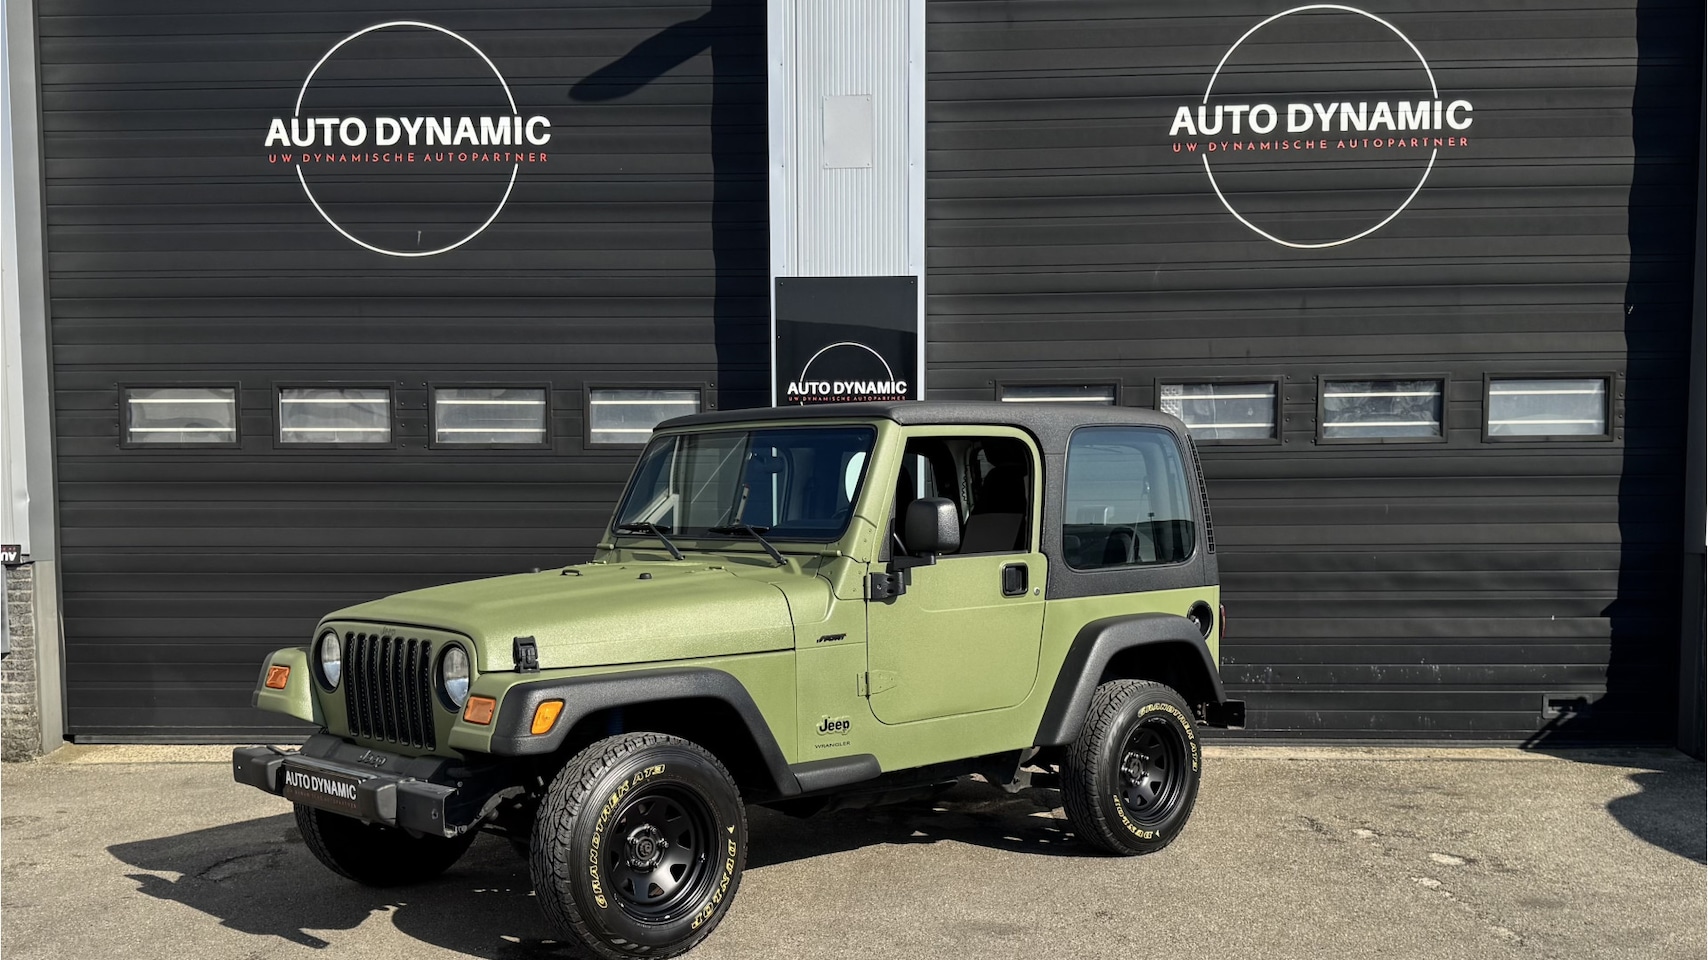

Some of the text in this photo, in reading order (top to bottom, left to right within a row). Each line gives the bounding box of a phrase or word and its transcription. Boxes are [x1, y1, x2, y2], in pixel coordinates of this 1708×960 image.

[264, 115, 551, 147] AUTO DYNAMIC
[1169, 99, 1474, 136] AUTO DYNAMIC
[268, 152, 548, 163] UW DYNAMISCHE AUTOPARTNER
[1173, 137, 1469, 152] UW DYNAMISCHE AUTOPARTNER
[787, 381, 907, 395] AUTO DYNAMIC
[819, 717, 850, 734] Jeep
[814, 740, 850, 750] WRANGLER
[285, 770, 310, 790] AUTO
[311, 776, 357, 800] DYNAMIC
[1112, 795, 1154, 839] DUNLOP
[589, 780, 630, 909] GRANDTREK
[691, 839, 737, 930] DUNLOP
